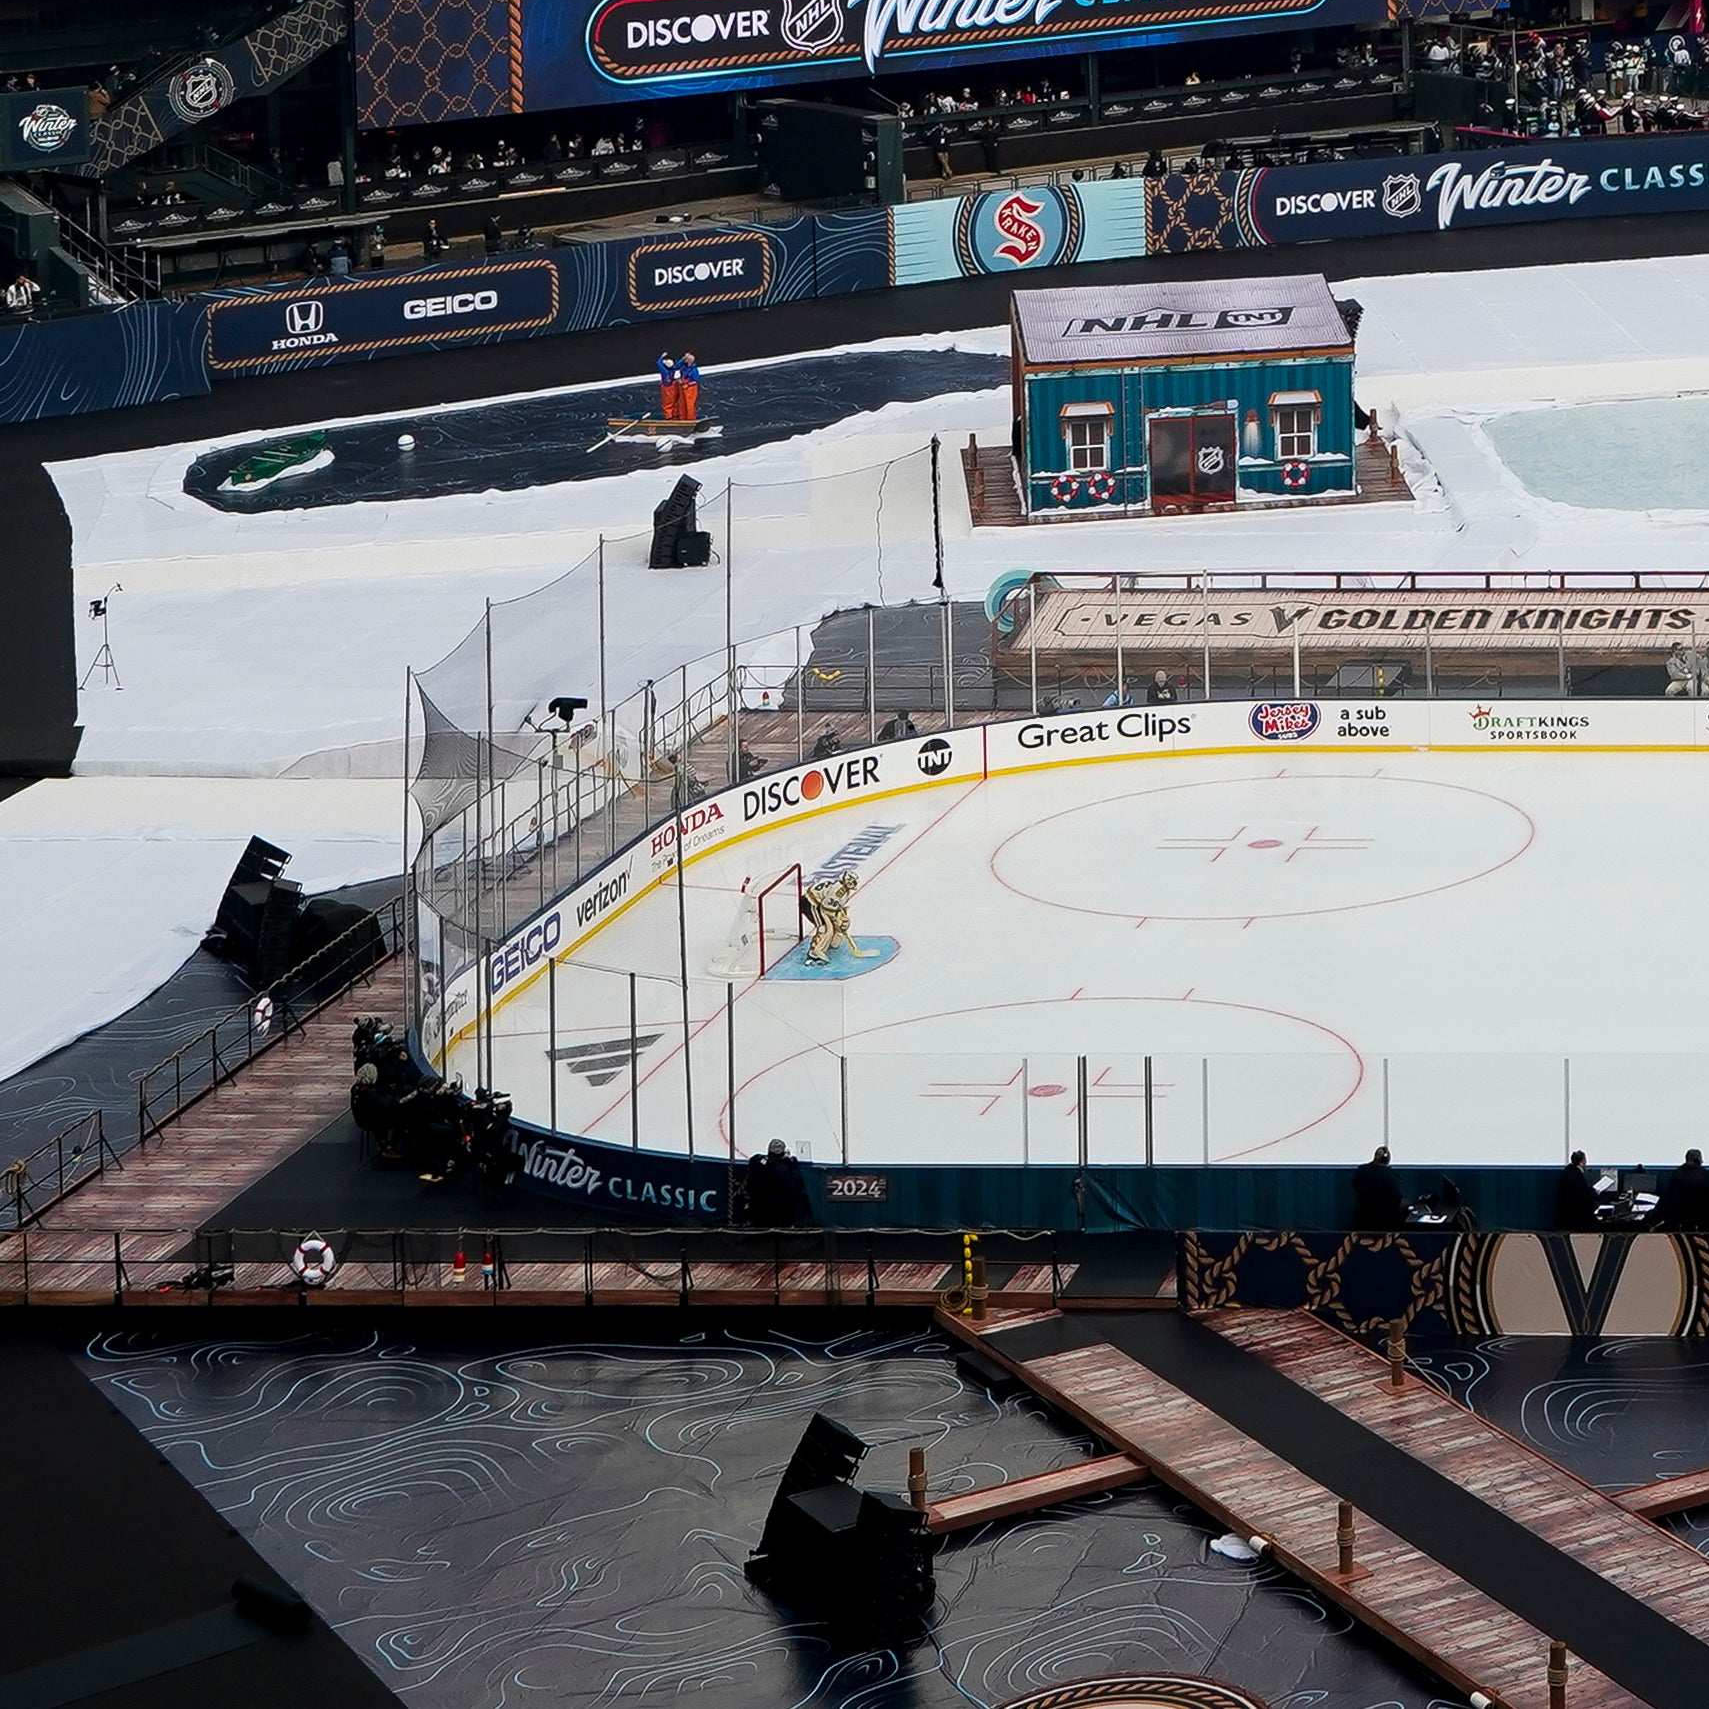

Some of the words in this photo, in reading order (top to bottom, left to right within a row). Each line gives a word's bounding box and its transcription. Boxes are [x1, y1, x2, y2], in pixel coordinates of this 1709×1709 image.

[626, 9, 770, 50] DISCOVER
[18, 114, 78, 142] Winter
[1276, 189, 1376, 216] DISCOVER
[1427, 159, 1592, 231] Winter
[1002, 204, 1038, 254] KRAKEN
[654, 258, 745, 285] DISCOVER
[403, 290, 498, 320] GEICO
[1080, 313, 1207, 333] NHL
[1229, 311, 1283, 322] TNT
[272, 331, 339, 351] HONDA
[1101, 611, 1252, 630] VEGAS
[1317, 608, 1500, 631] GOLDEN
[1502, 608, 1694, 631] KNIGHTS
[1260, 704, 1310, 721] Jersey
[1356, 706, 1386, 720] sub
[1474, 715, 1590, 731] DRAFTKINGS
[1017, 718, 1109, 750] Great
[1116, 712, 1191, 743] Clips
[1337, 722, 1390, 737] above
[1490, 730, 1578, 741] SPORTSBOOK
[918, 749, 951, 772] TNT
[742, 756, 881, 821] DISCOVER
[650, 803, 724, 858] HONDA
[576, 868, 628, 928] verizon
[491, 912, 562, 995] GEICO
[607, 1176, 718, 1214] CLASSIC
[832, 1177, 882, 1199] 2024
